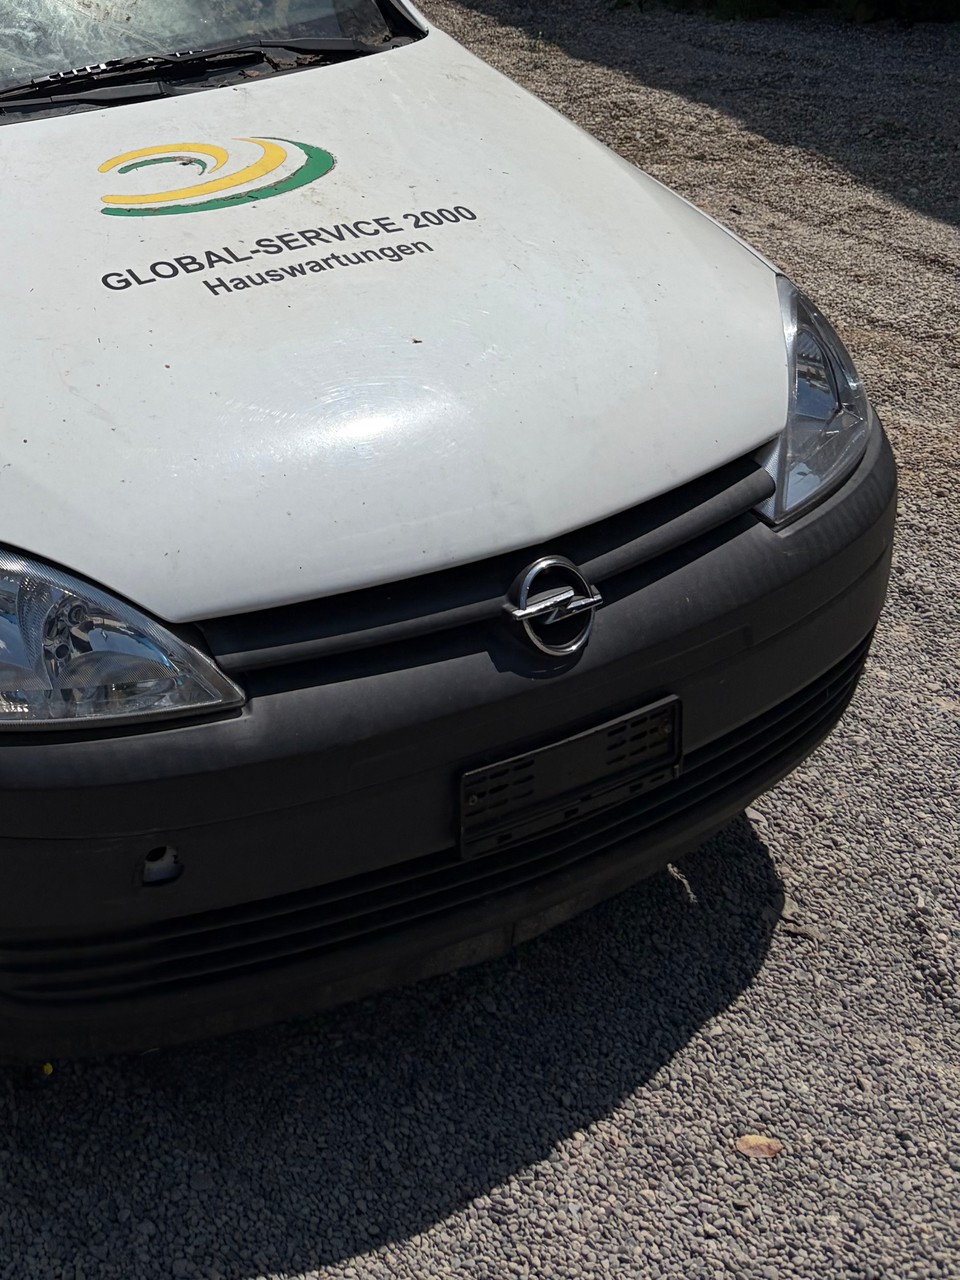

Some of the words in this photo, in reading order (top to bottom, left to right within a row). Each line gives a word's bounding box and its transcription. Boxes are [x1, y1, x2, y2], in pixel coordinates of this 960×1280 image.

[101, 216, 405, 292] GLOBAL-SERVICE
[402, 205, 478, 234] 2000
[202, 237, 435, 297] Hauswartungen
